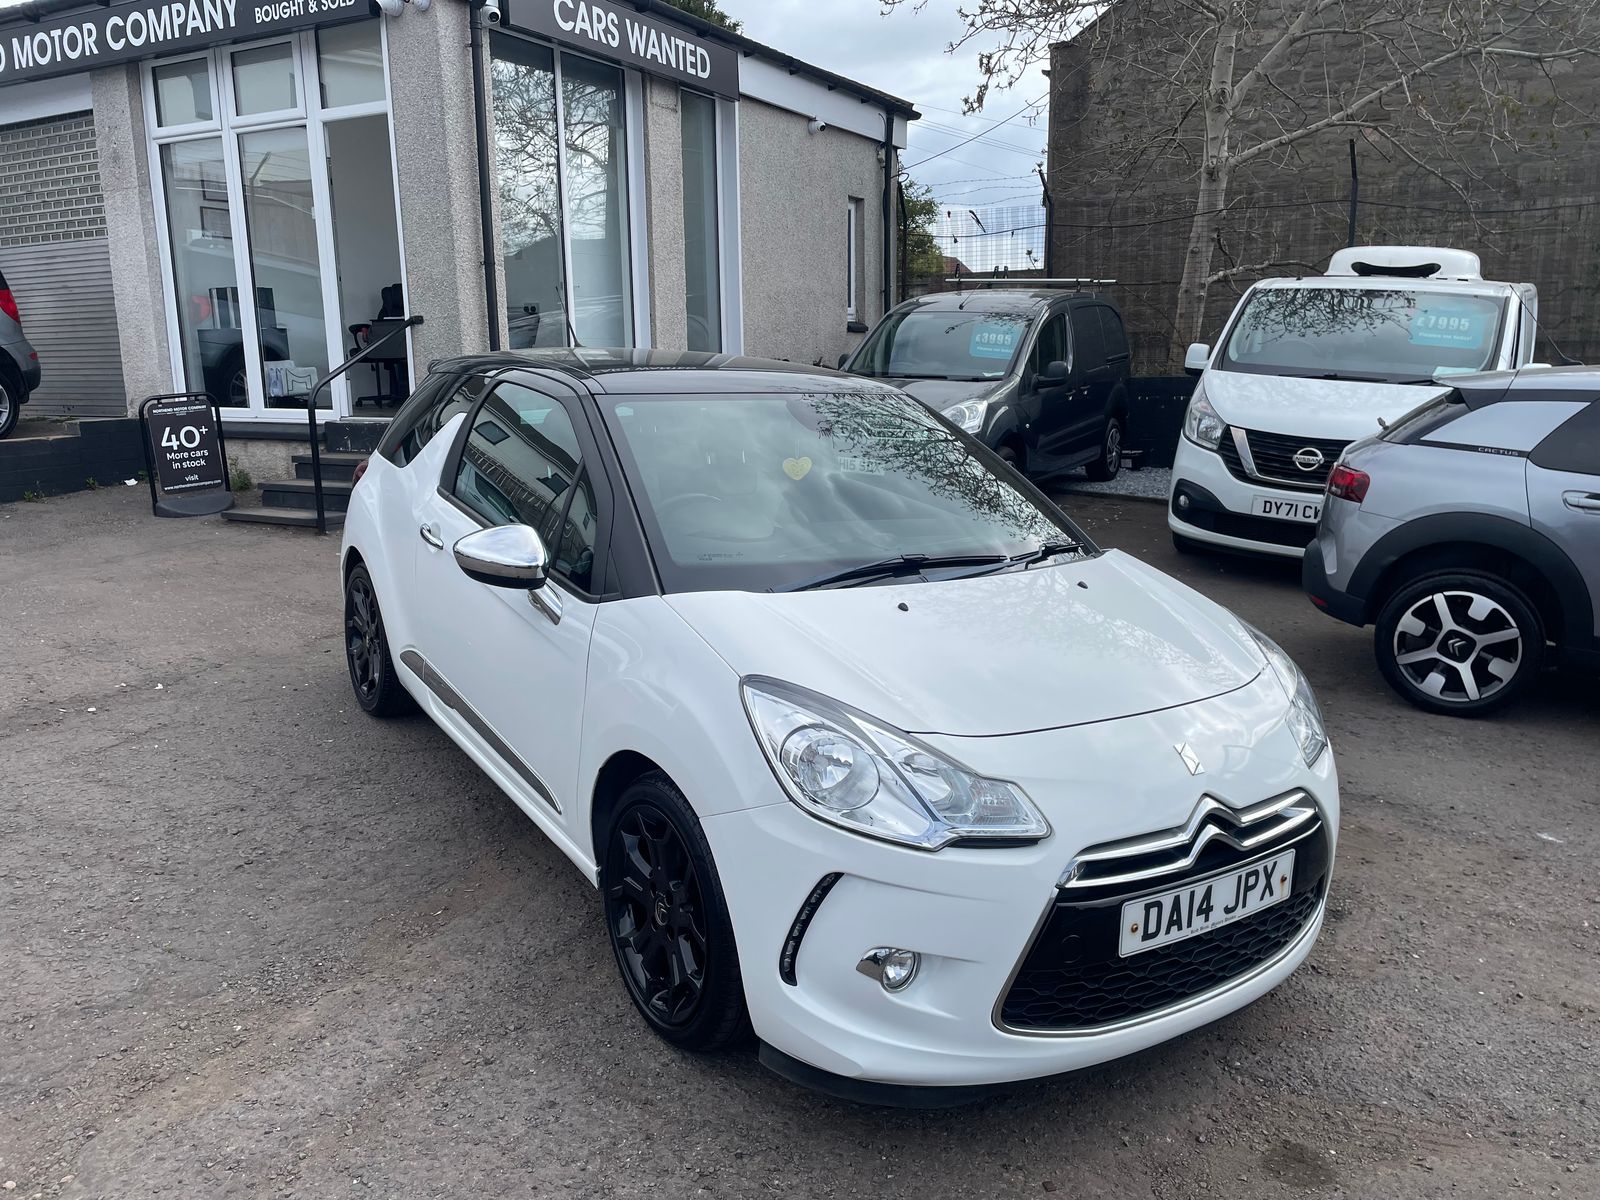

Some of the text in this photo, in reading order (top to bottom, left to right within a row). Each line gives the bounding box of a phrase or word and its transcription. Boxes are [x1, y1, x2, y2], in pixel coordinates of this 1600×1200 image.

[254, 0, 304, 24] BOUGHT
[12, 22, 99, 70] MOTOR
[106, 0, 237, 51] COMPANY
[554, 0, 711, 79] CARS WANTED
[166, 449, 209, 461] More cars
[1295, 456, 1320, 464] NISSAN
[1478, 447, 1519, 456] CACTUS
[172, 458, 206, 469] in stock
[1262, 500, 1298, 517] DY71
[1141, 861, 1278, 942] DA14 JPX
